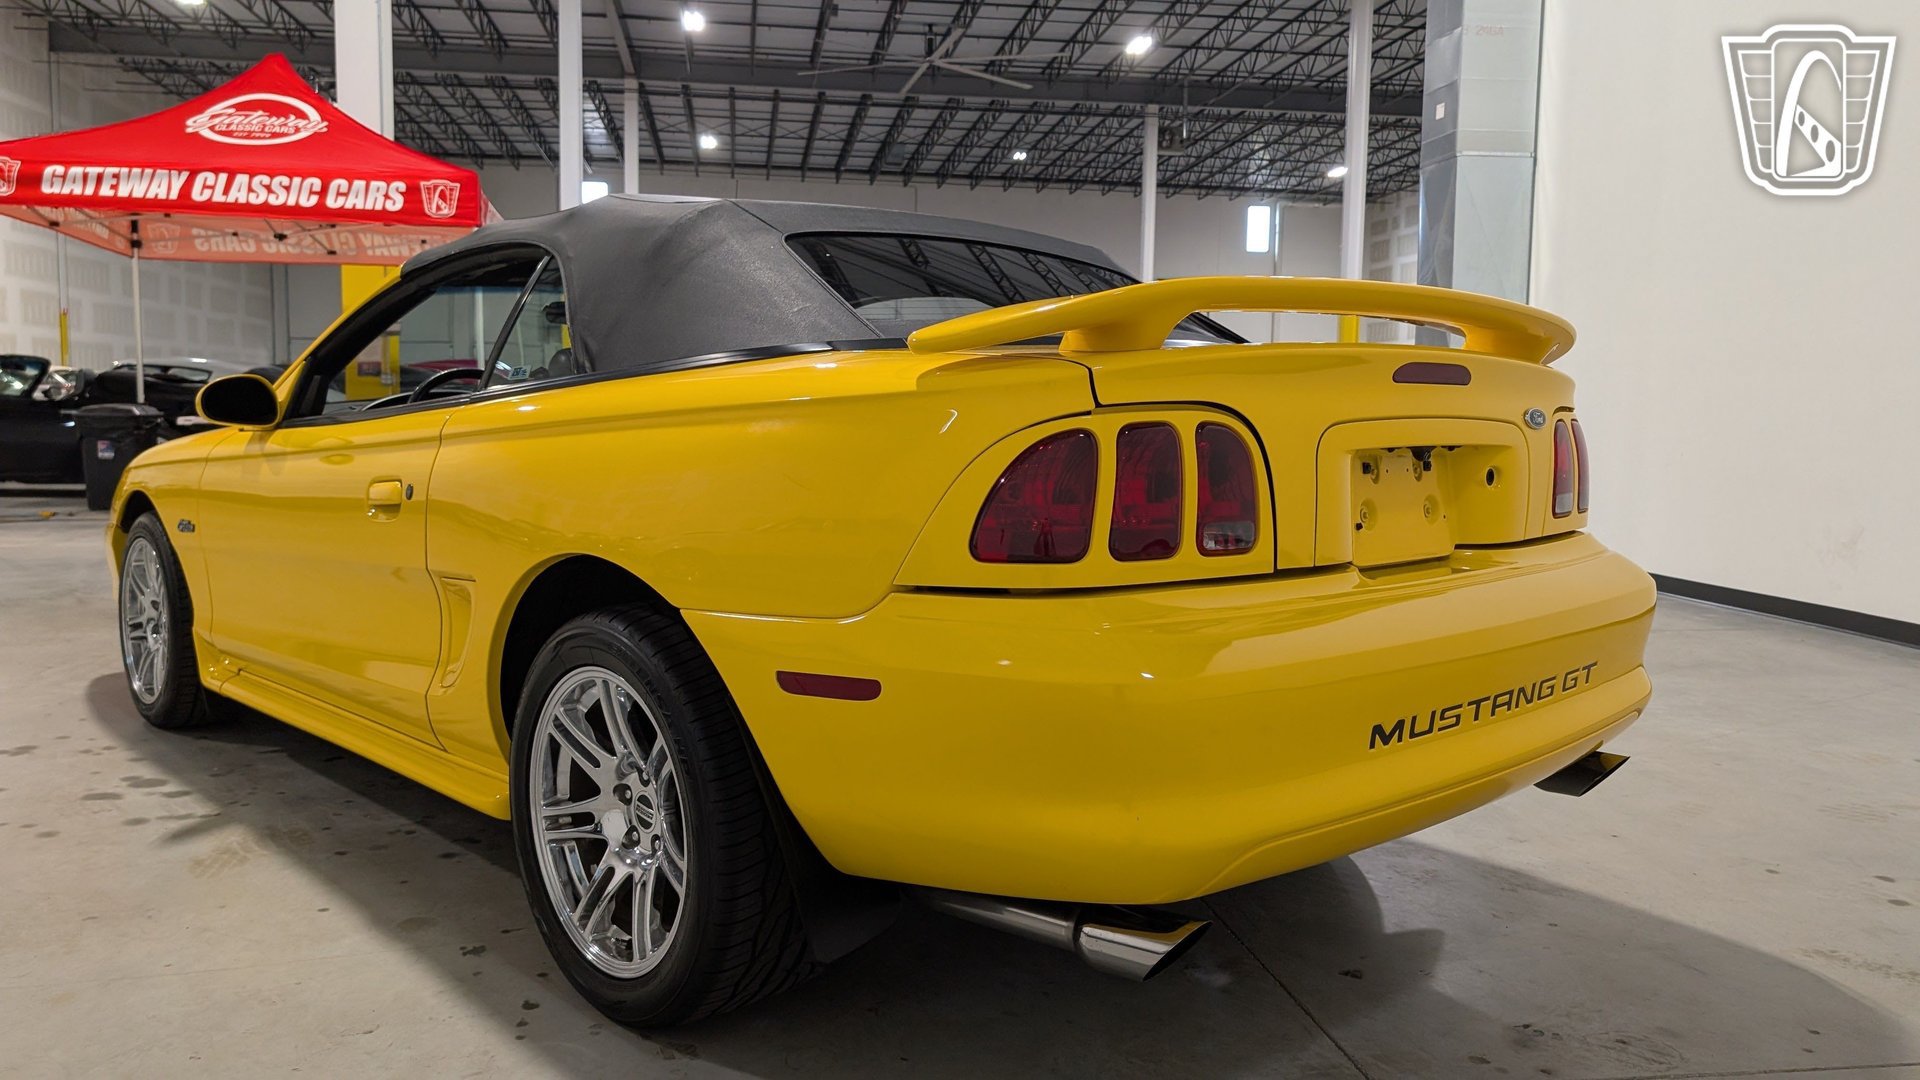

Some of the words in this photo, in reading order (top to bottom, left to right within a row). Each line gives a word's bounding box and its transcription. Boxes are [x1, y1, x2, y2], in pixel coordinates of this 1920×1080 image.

[185, 107, 329, 133] Gateway
[214, 123, 264, 132] CLASSIC
[264, 125, 296, 134] CARS
[41, 164, 190, 200] GATEWAY
[191, 171, 321, 207] CLASSIC
[326, 178, 407, 212] CARS
[1369, 675, 1558, 750] MUSTANG
[1562, 661, 1598, 692] GT
